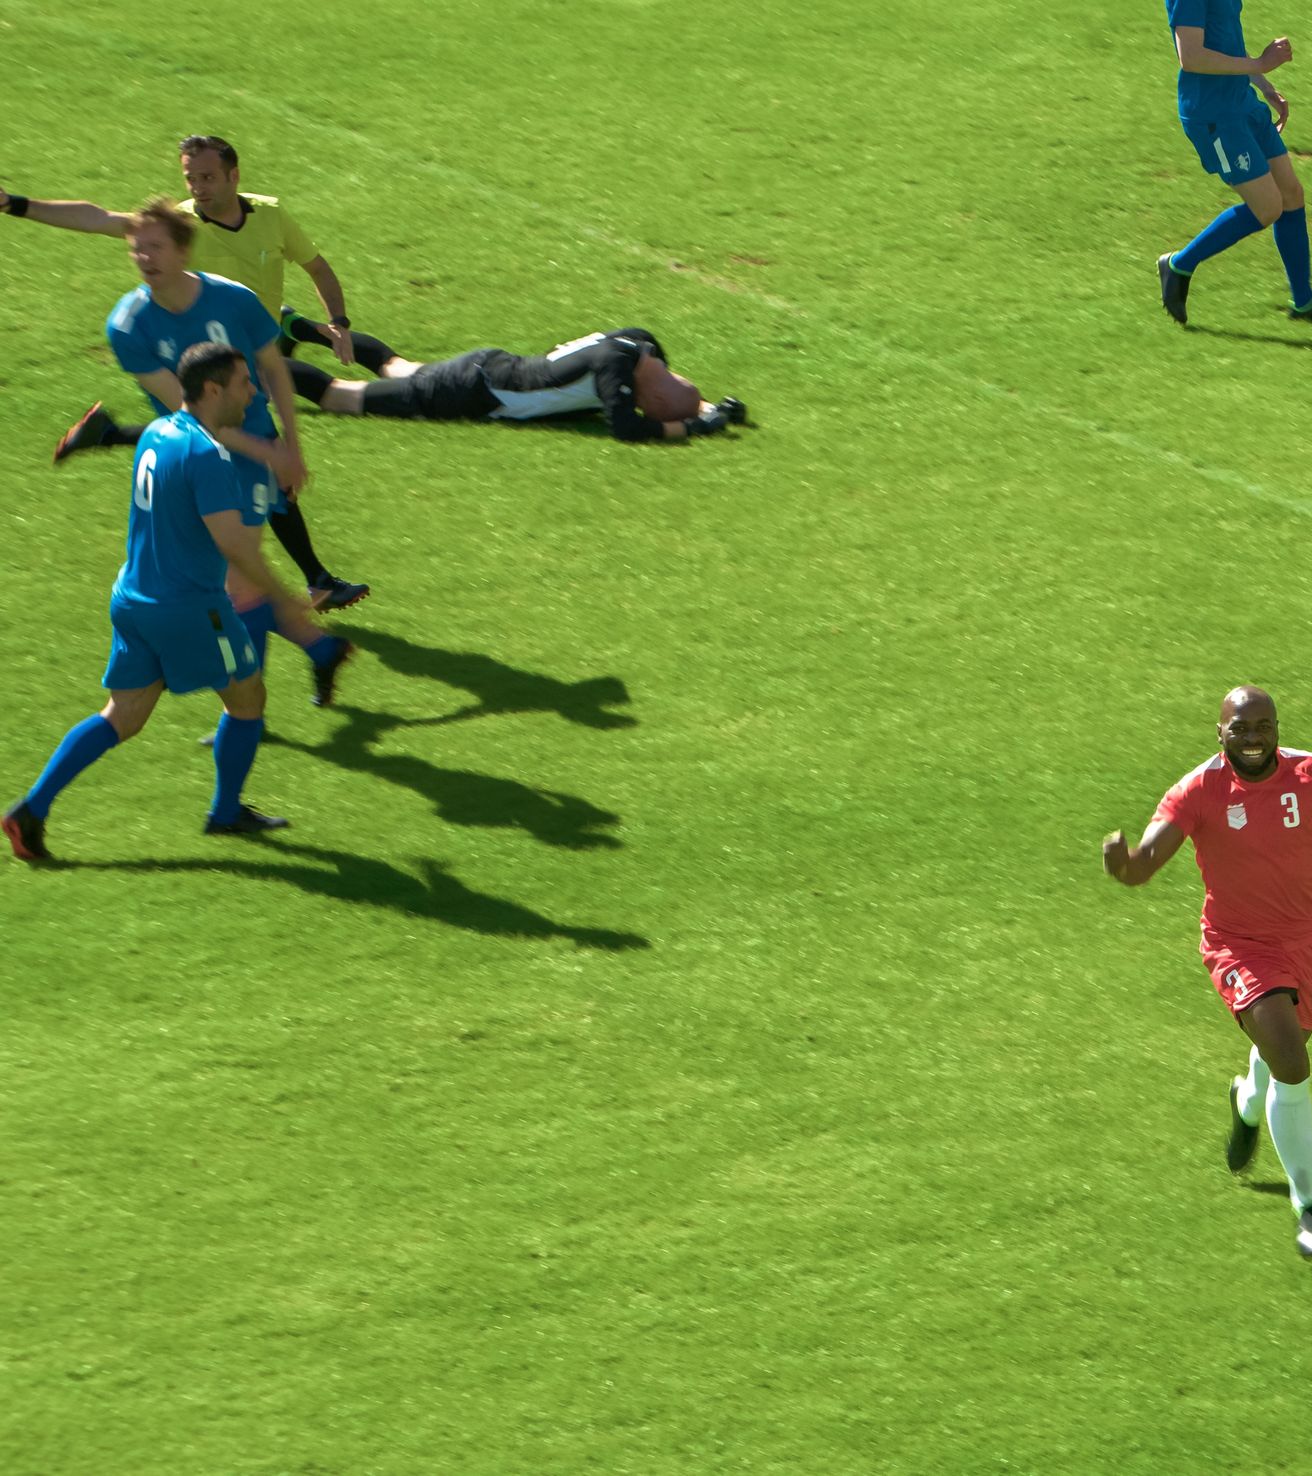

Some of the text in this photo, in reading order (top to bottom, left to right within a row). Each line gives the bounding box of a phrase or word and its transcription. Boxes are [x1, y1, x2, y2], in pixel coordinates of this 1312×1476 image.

[134, 448, 157, 512] 6
[1281, 793, 1300, 828] 3
[1226, 969, 1248, 1001] 3
